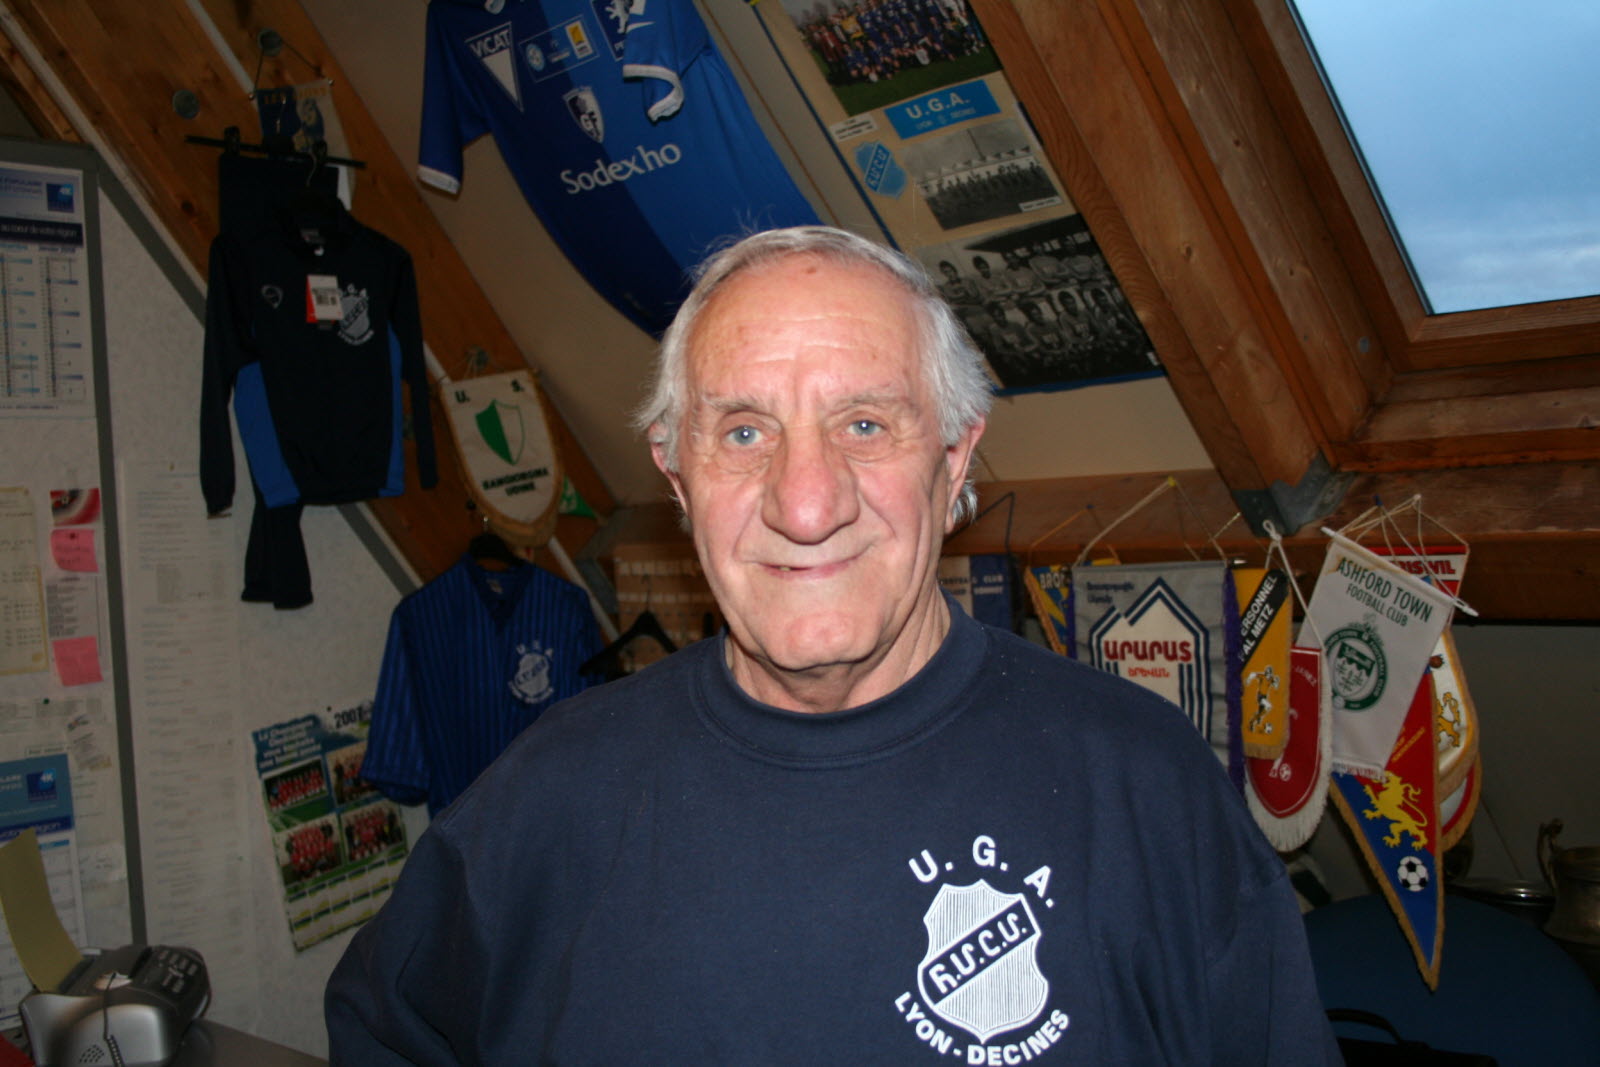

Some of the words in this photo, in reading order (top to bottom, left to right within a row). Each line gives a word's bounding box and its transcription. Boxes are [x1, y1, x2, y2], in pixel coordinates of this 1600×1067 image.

[469, 29, 510, 59] VICAT
[905, 91, 971, 119] U.G.A.
[560, 143, 682, 195] Sodexho
[1338, 557, 1392, 598] ASHFORD
[1393, 587, 1433, 623] TOWN
[1346, 583, 1386, 616] FOOTBALL
[1386, 606, 1409, 627] CLUB
[1250, 602, 1275, 639] METZ
